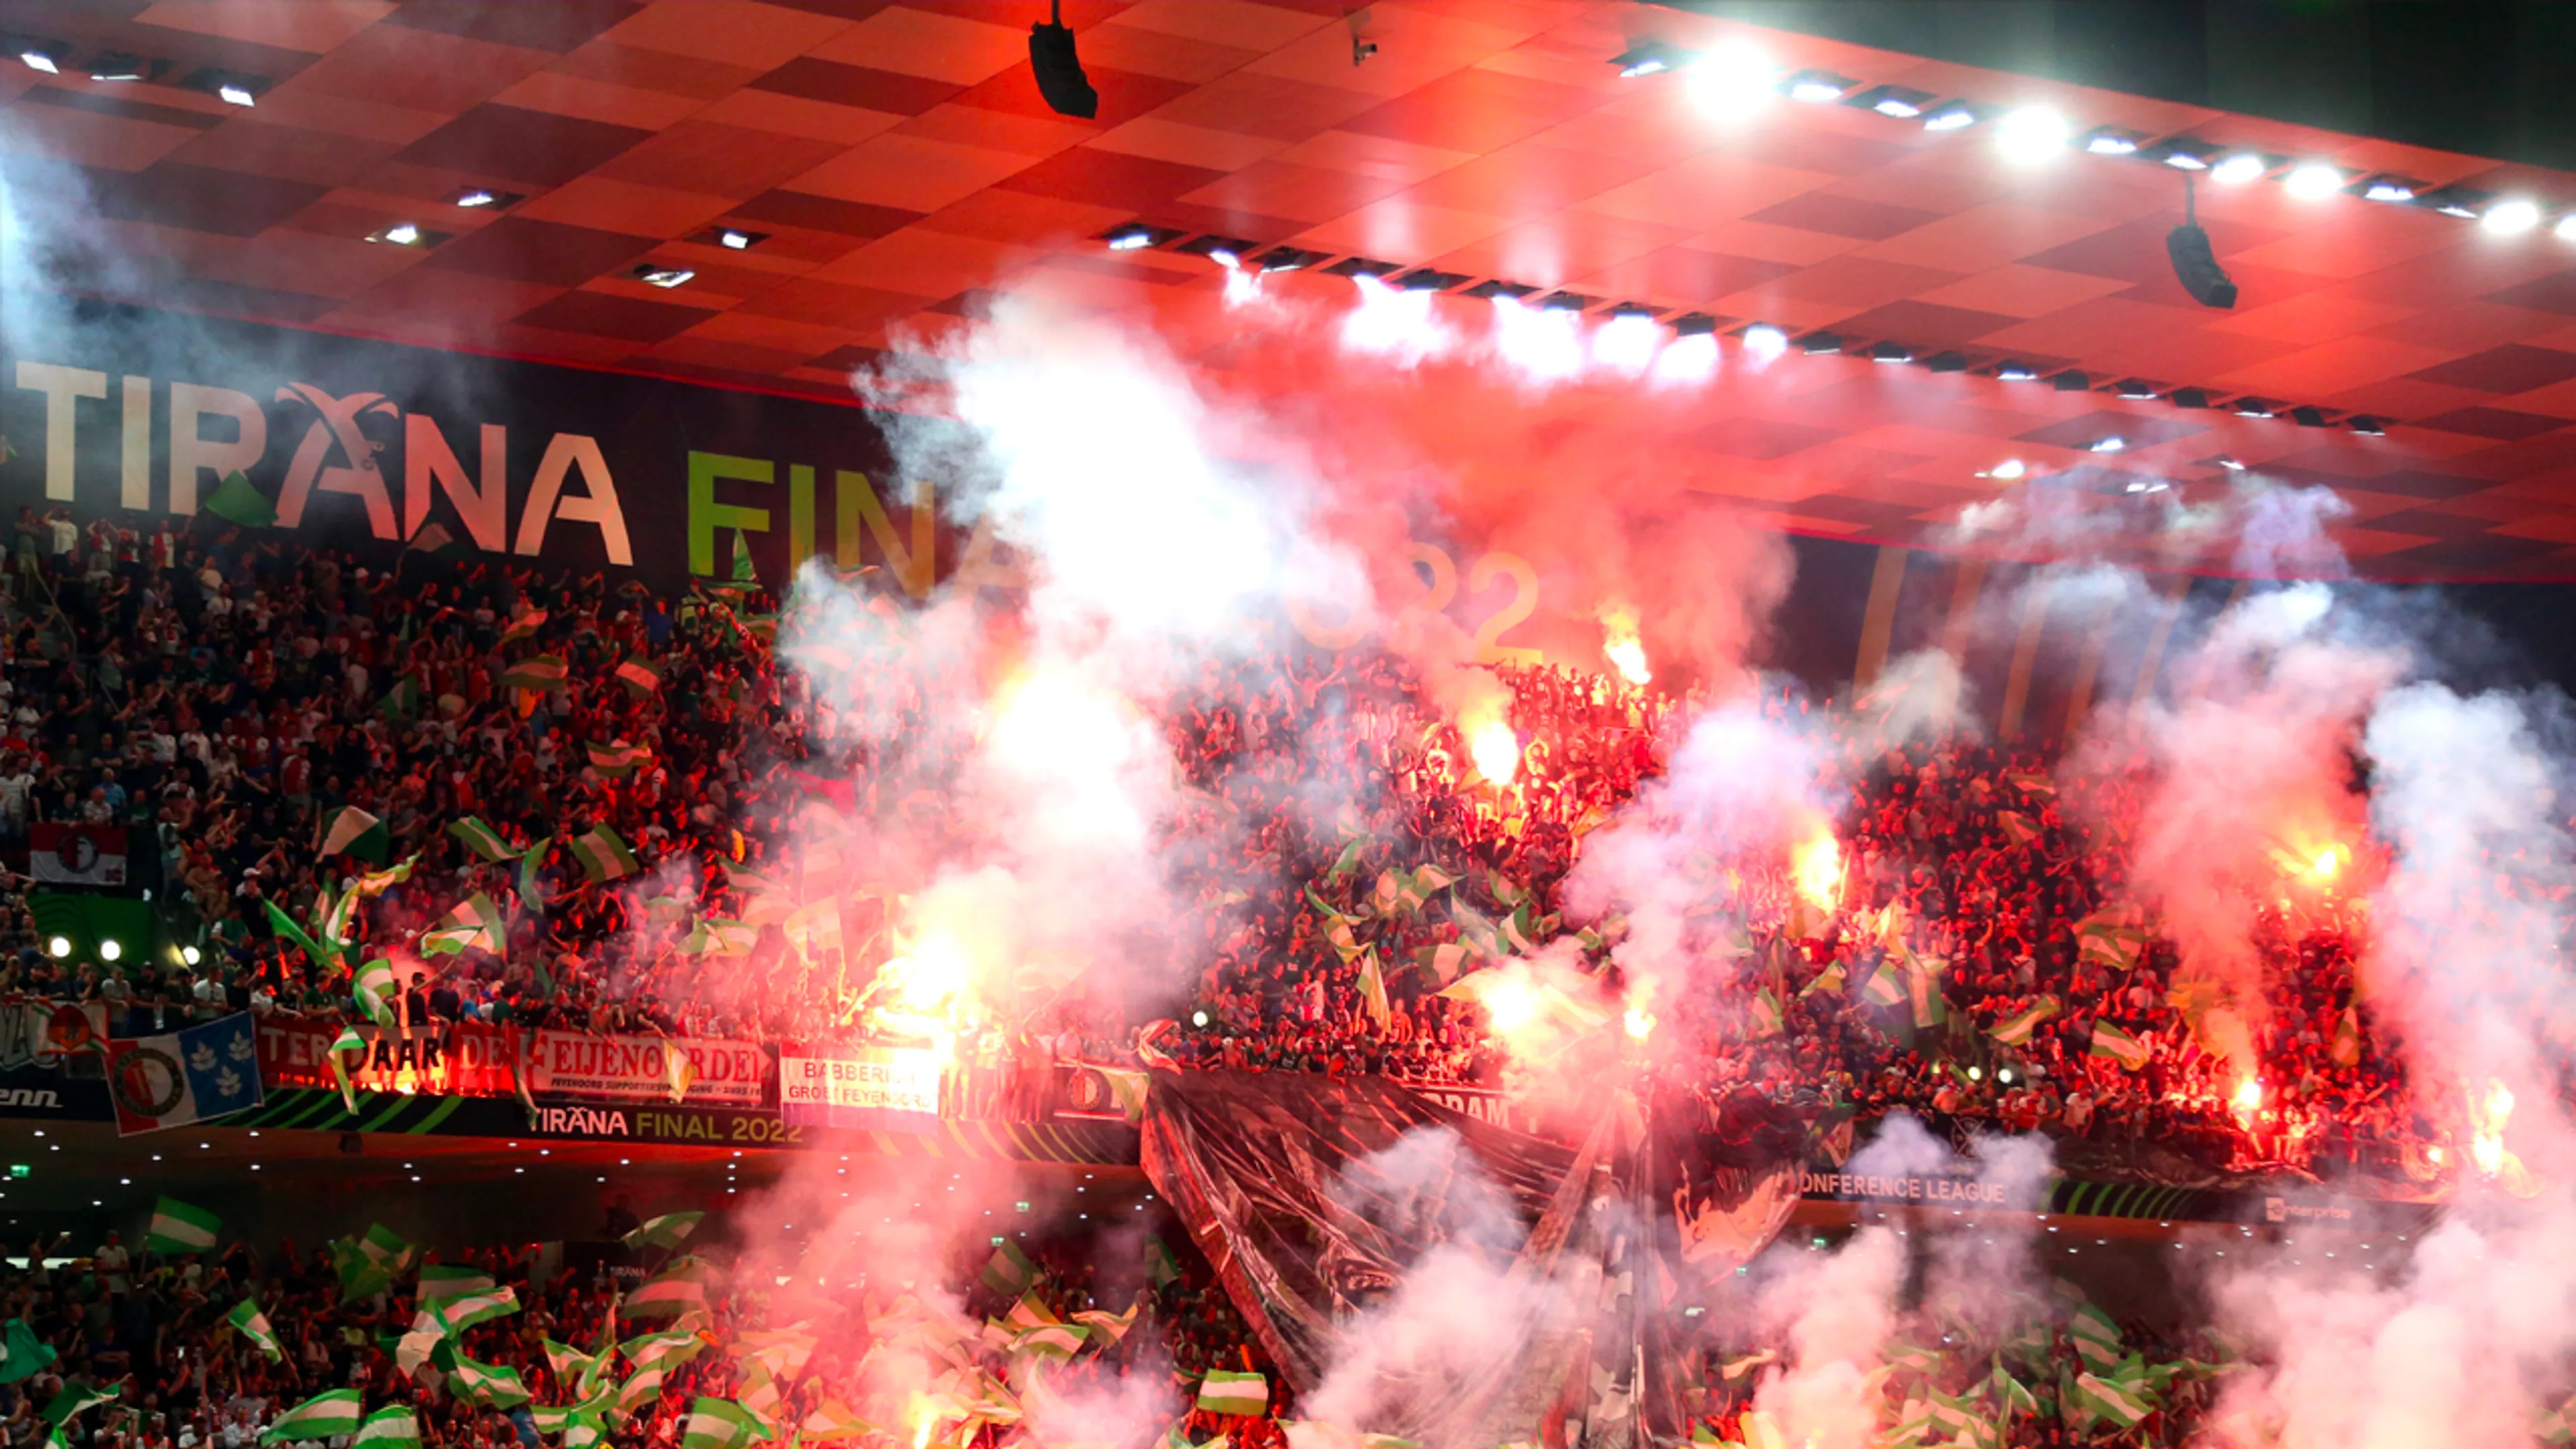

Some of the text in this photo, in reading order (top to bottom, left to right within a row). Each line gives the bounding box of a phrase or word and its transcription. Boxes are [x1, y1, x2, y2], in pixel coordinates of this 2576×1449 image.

[688, 450, 1038, 604] FINA
[461, 1034, 504, 1071] DE
[637, 1112, 723, 1140] FINAL
[1802, 1173, 2006, 1203] ONFERENCE LEAGUE
